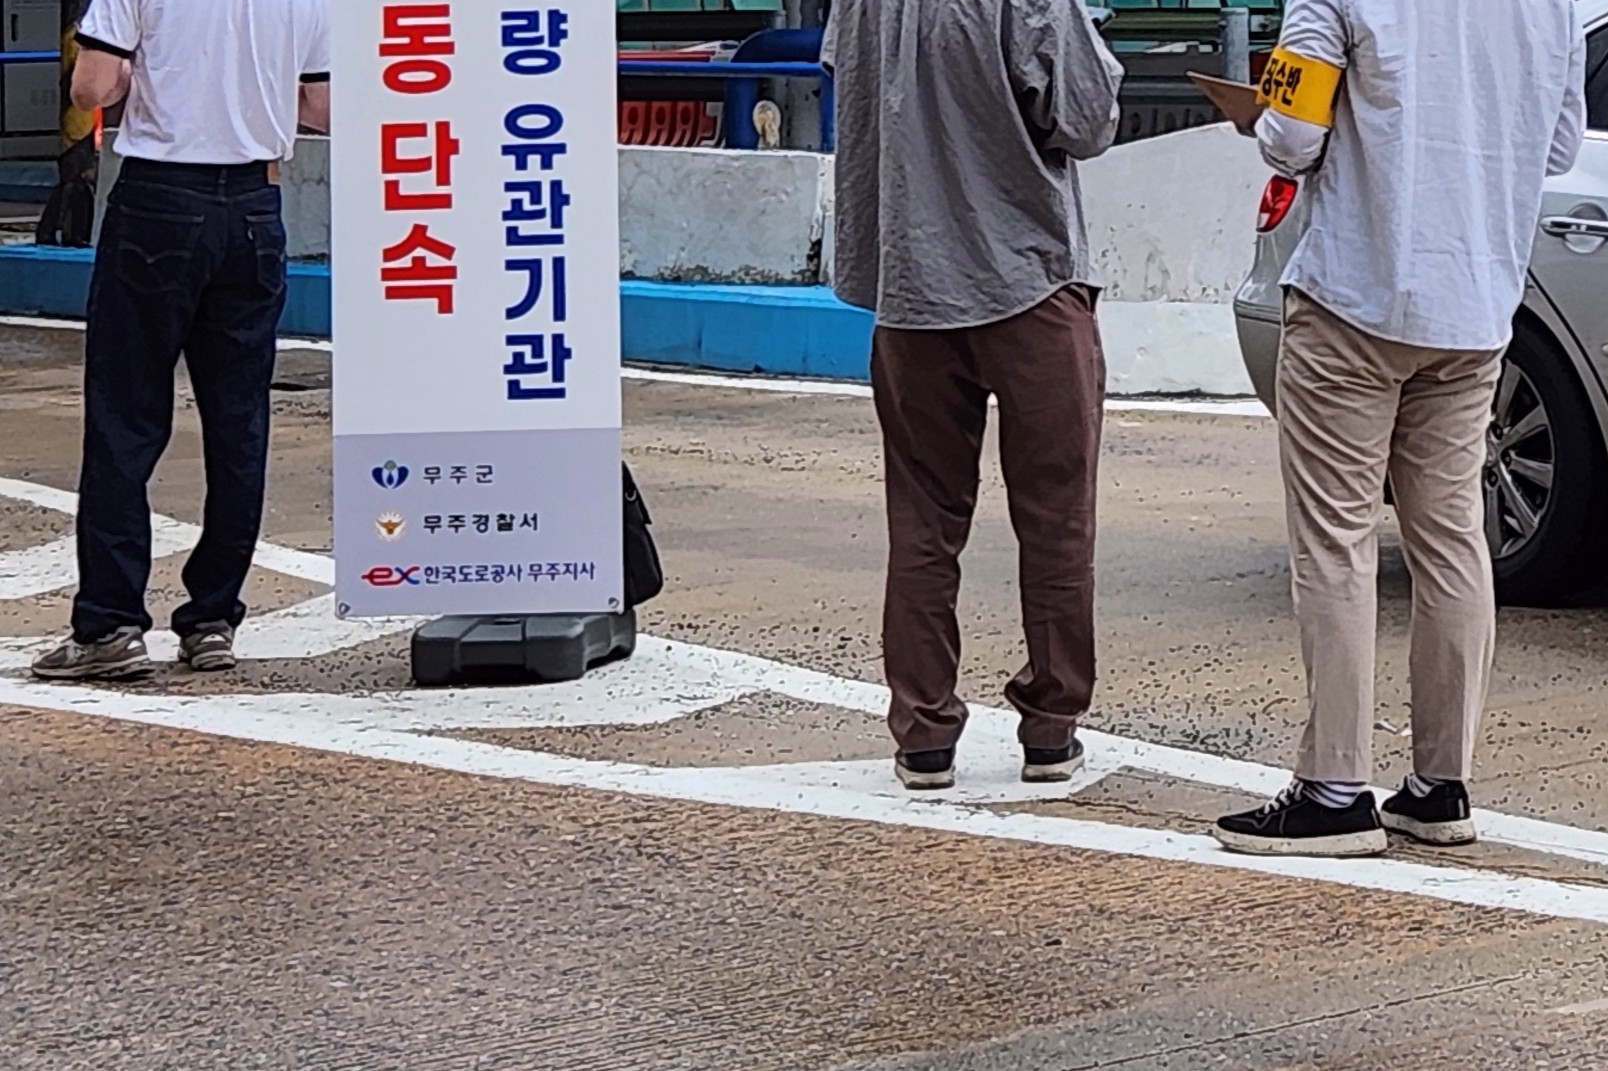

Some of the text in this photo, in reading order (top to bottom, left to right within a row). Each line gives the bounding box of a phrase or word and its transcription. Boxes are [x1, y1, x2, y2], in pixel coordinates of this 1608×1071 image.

[501, 103, 572, 401] 유관기관
[422, 464, 495, 485] 무주군
[422, 512, 539, 534] 무주경찰서
[423, 564, 523, 584] 한국도로공사
[527, 561, 595, 582] 무주지사
